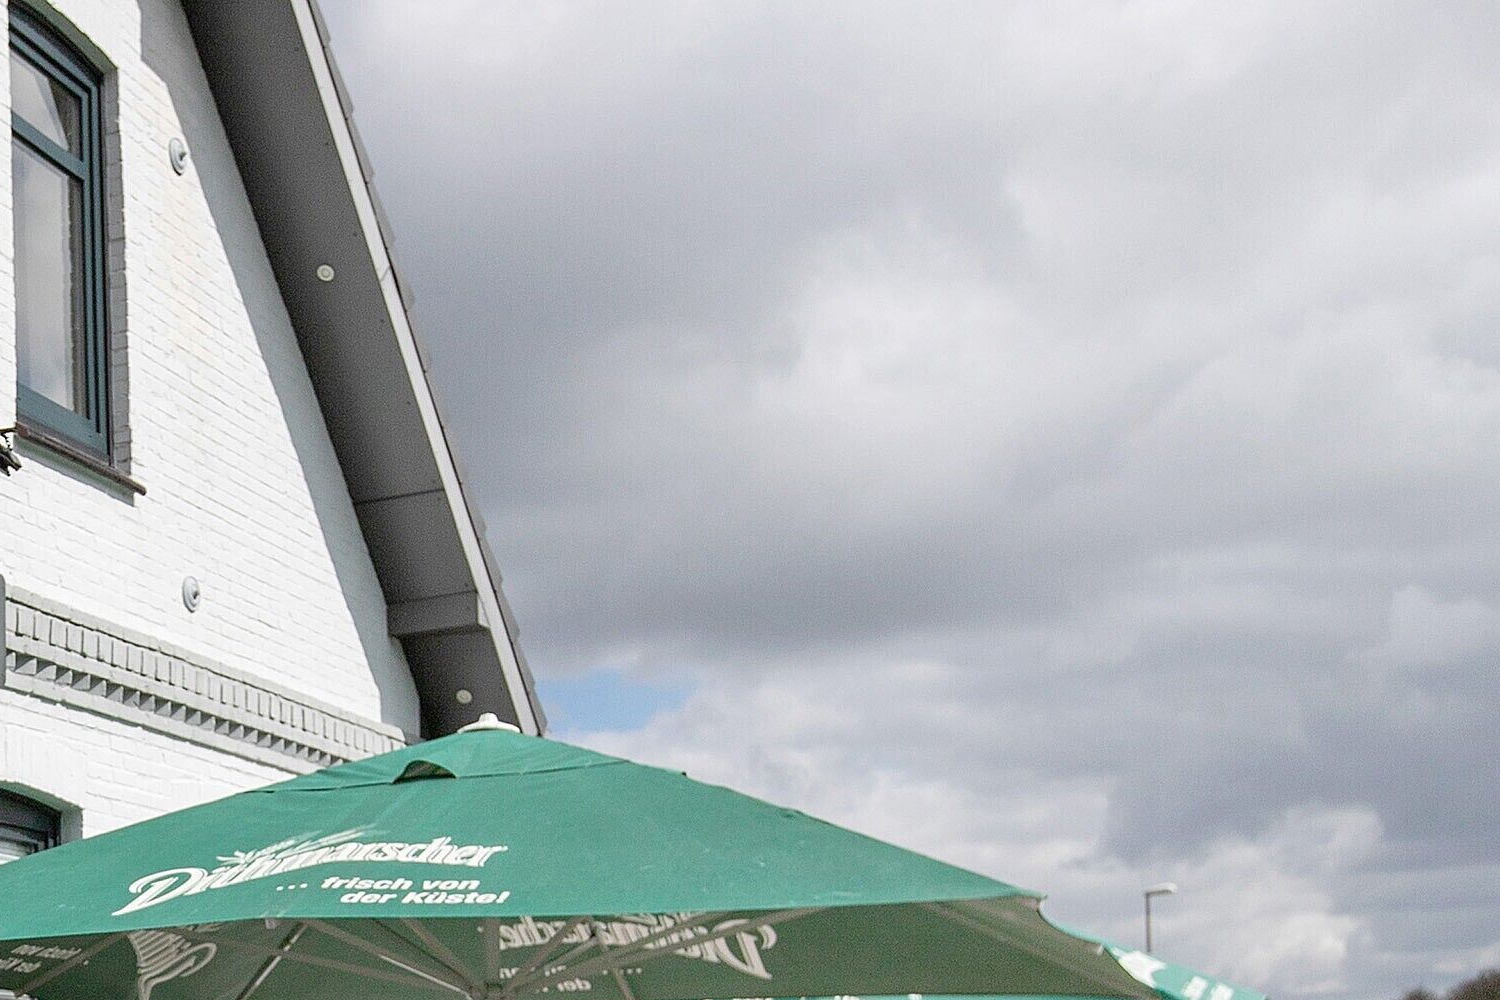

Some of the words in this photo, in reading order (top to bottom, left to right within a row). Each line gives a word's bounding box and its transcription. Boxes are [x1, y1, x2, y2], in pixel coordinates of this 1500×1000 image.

[320, 876, 413, 890] frisch
[422, 878, 481, 890] von
[340, 891, 398, 904] der
[401, 890, 511, 904] Küste!
